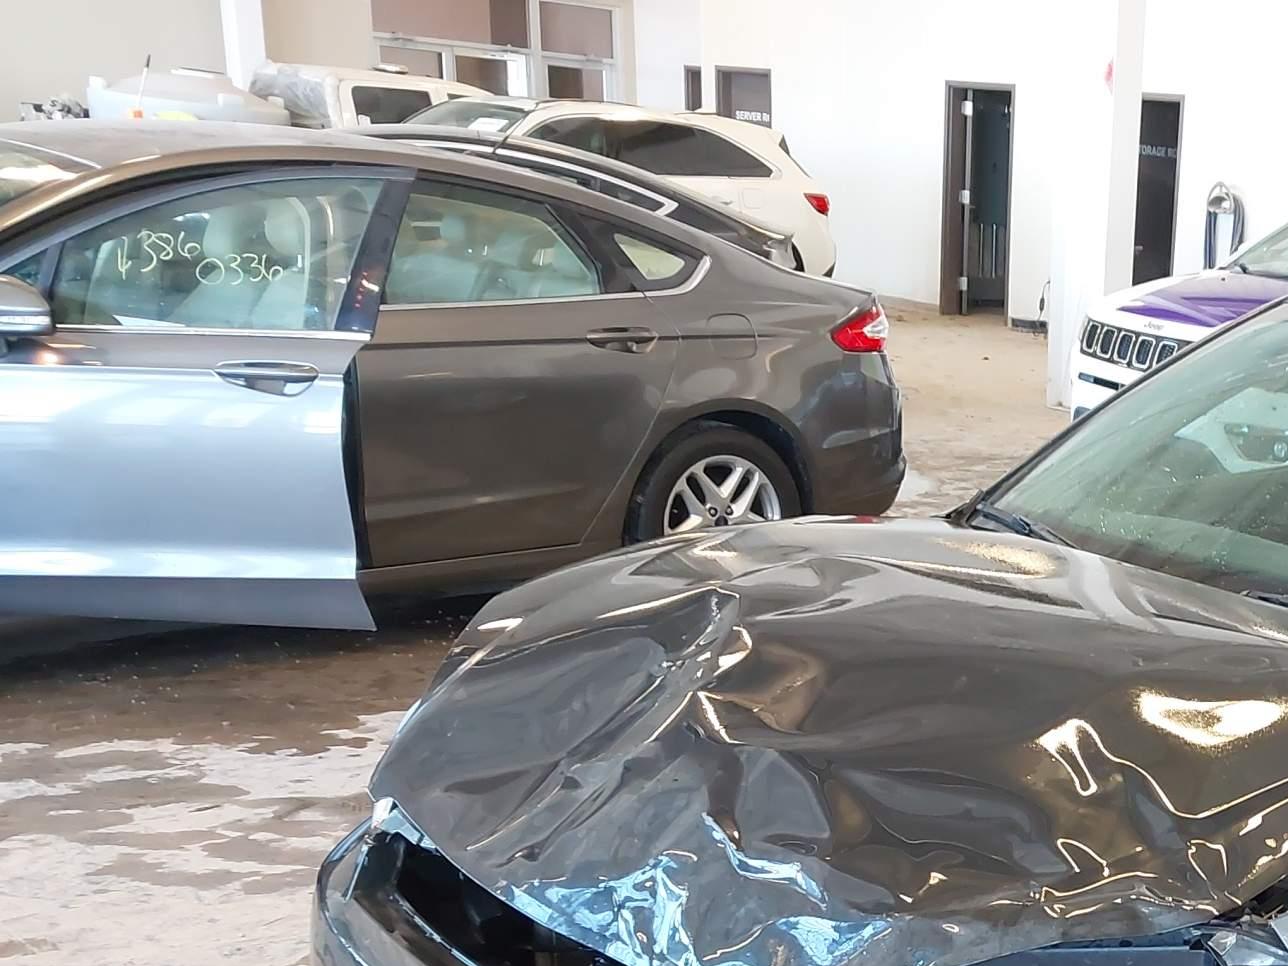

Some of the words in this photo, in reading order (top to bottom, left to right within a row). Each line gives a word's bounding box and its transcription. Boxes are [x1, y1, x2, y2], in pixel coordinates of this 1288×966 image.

[735, 110, 761, 121] SERVER
[118, 230, 200, 280] 4386
[196, 253, 283, 285] 0336
